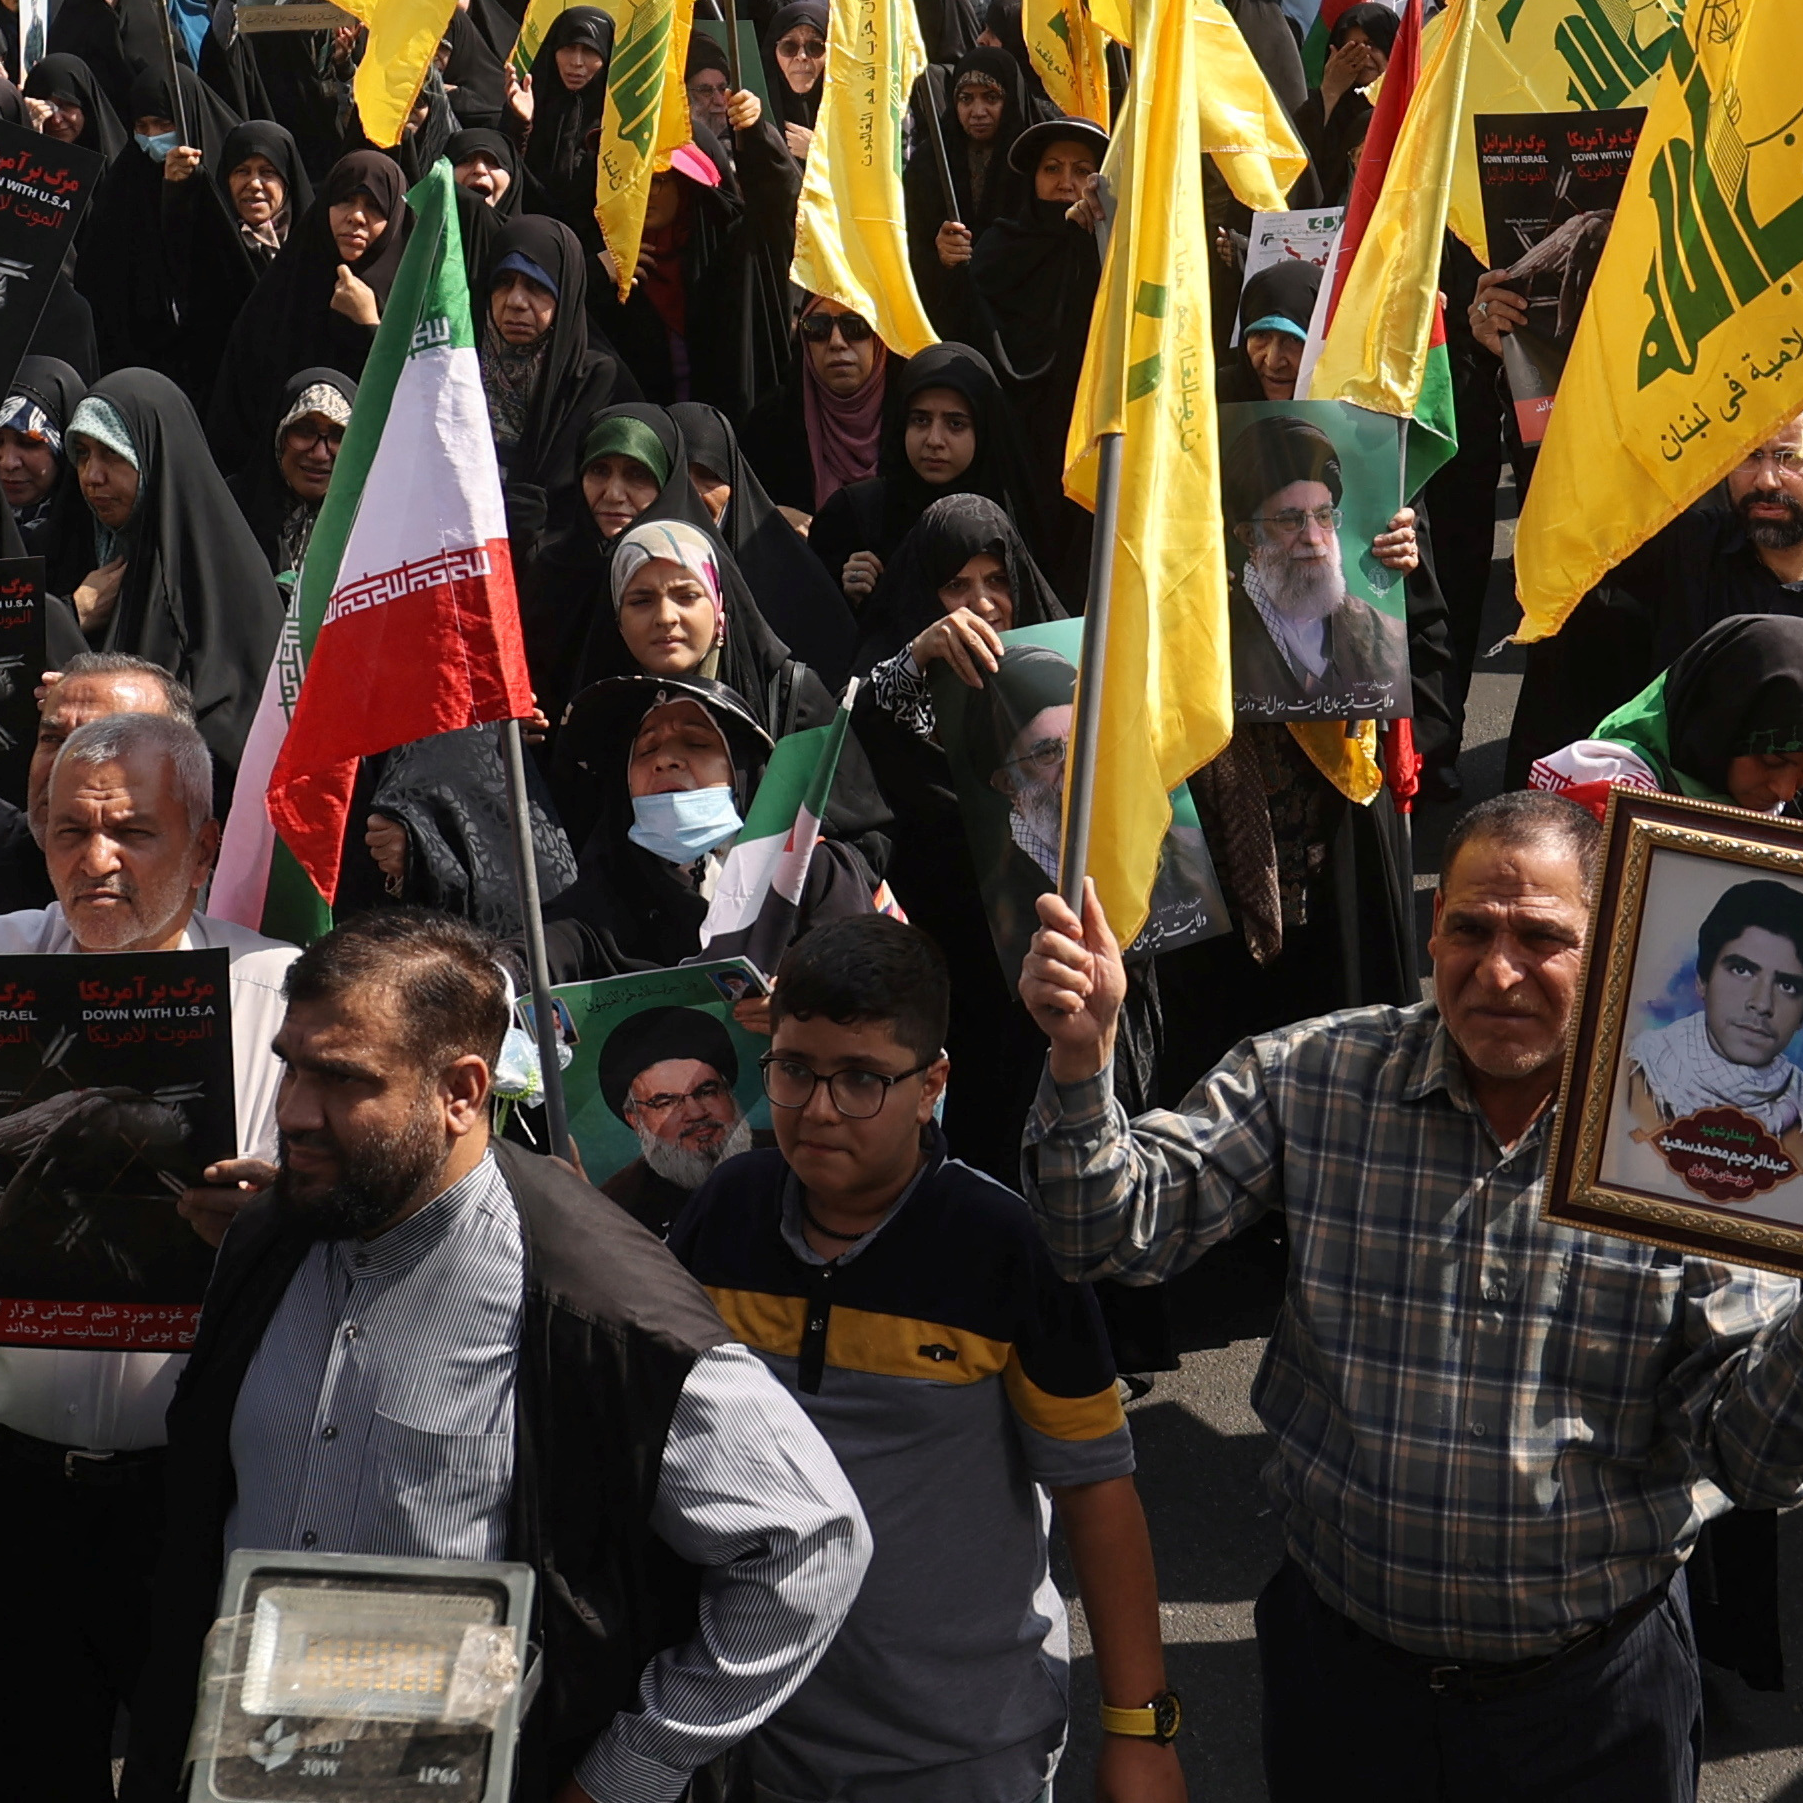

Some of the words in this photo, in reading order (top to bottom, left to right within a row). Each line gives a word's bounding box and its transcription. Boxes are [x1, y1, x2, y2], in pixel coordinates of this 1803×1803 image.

[1482, 155, 1502, 164] DOWN
[1503, 155, 1520, 163] WITH
[1521, 155, 1549, 164] ISRAEL
[1572, 153, 1599, 162] DOWN
[1600, 151, 1622, 160] WITH
[20, 165, 42, 183] بر
[43, 168, 81, 193] مرگ
[6, 179, 38, 198] WITH
[38, 191, 71, 210] U.S.A
[1661, 402, 1712, 462] لبنان
[4, 599, 34, 608] U.S.A
[145, 986, 166, 1006] بر
[169, 976, 215, 1005] مرگ
[82, 1008, 131, 1021] DOWN
[132, 1006, 172, 1020] WITH
[175, 1005, 216, 1017] U.S.A
[8, 1300, 35, 1319] قرار
[40, 1304, 85, 1320] کسانی
[90, 1305, 117, 1321] ظلم
[122, 1308, 153, 1324] مورد
[158, 1307, 185, 1324] غزه
[63, 1324, 119, 1337] انسانیت
[125, 1325, 135, 1342] از
[299, 1759, 341, 1776] 30W
[417, 1766, 461, 1784] IP66
